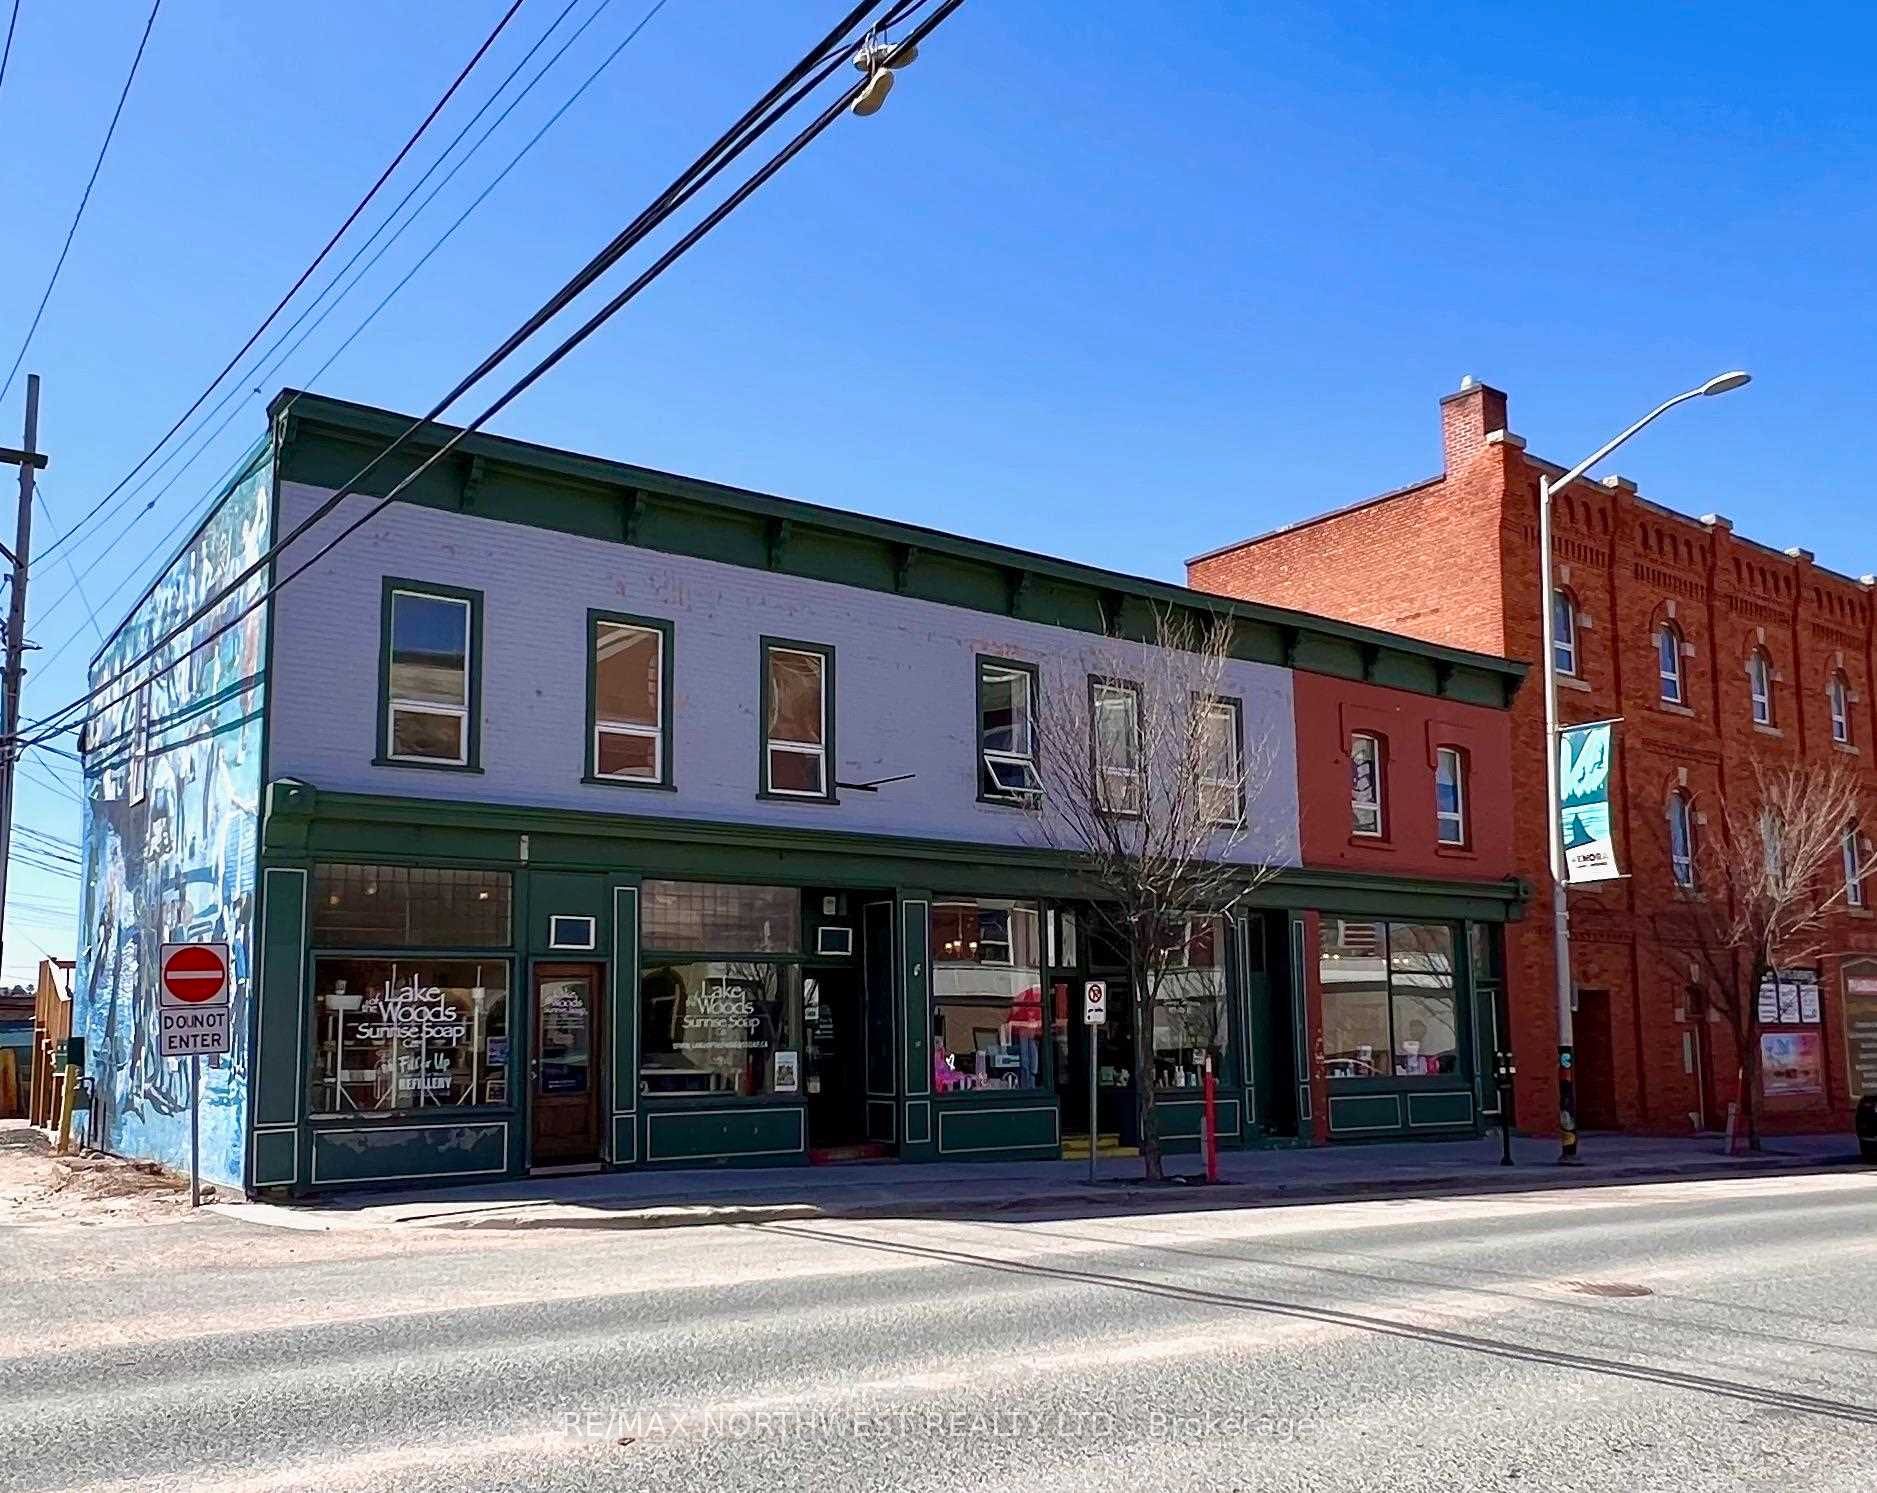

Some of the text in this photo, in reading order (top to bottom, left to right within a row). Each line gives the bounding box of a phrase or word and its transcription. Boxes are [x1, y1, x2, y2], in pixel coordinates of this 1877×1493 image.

[385, 973, 441, 1002] Lake
[701, 975, 743, 998] Lake
[379, 993, 456, 1022] Woods
[698, 991, 754, 1015] Woods
[164, 1013, 225, 1030] DO NOT
[727, 1014, 760, 1036] Soap
[168, 1032, 222, 1050] ENTER
[356, 1022, 465, 1047] Sunrise Soap
[434, 1052, 450, 1072] Up
